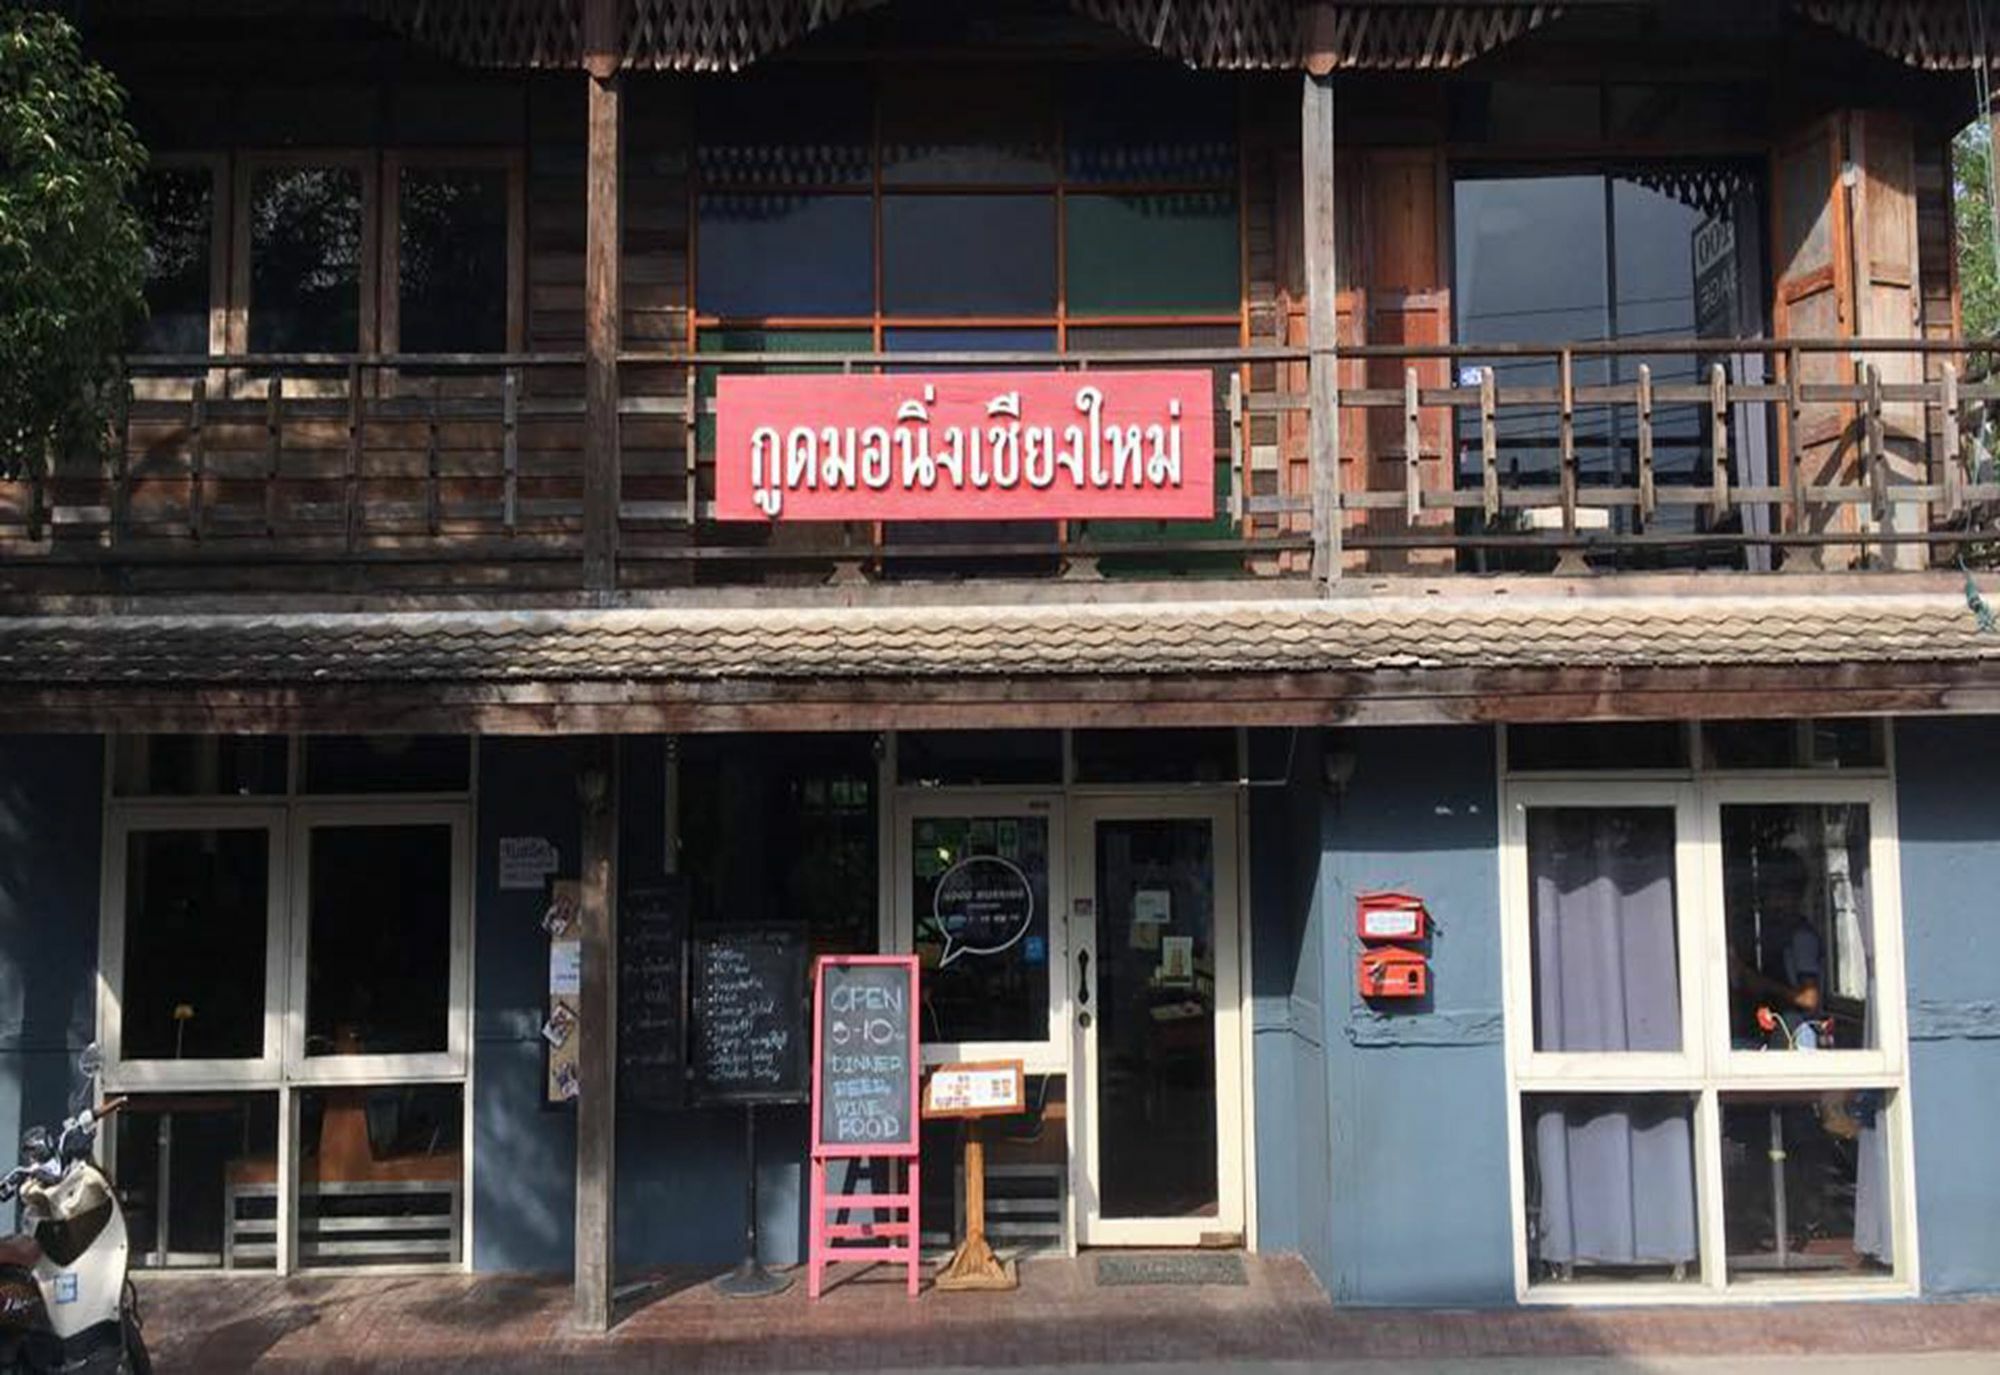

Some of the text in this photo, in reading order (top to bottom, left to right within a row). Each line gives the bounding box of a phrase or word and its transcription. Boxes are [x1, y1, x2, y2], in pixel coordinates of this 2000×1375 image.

[751, 384, 1182, 517] กูดมอนิ่งเชียงใหม่
[831, 985, 902, 1014] OPEN
[832, 1055, 904, 1074] DINNER
[838, 1114, 900, 1141] FOOD
